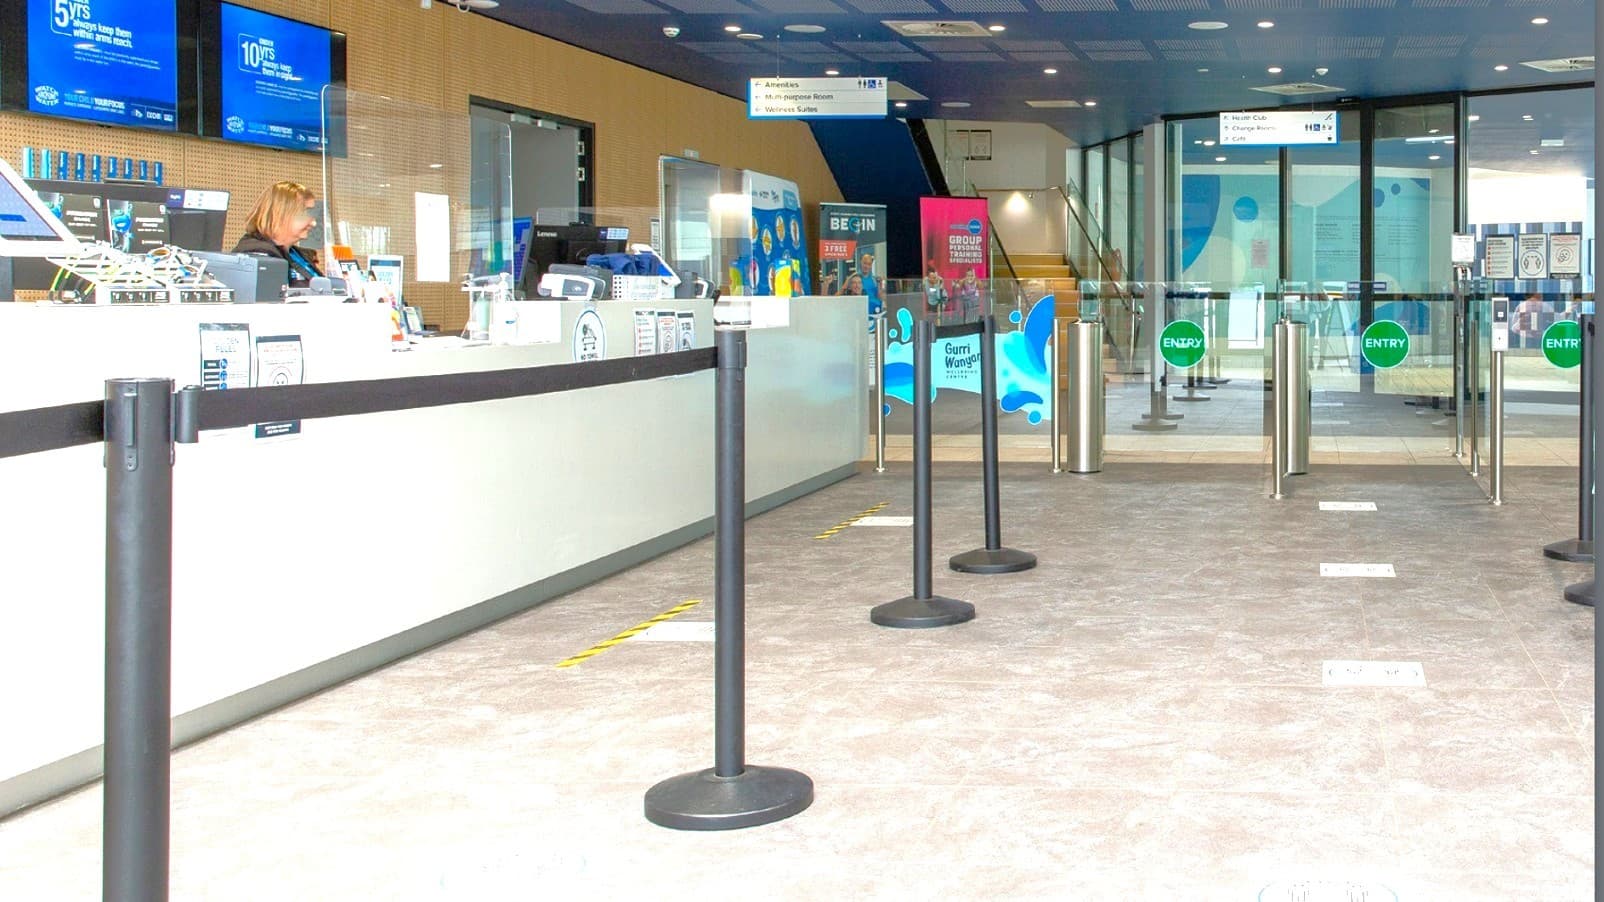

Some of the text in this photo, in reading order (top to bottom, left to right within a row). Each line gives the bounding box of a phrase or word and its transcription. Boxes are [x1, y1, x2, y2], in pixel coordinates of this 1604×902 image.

[54, 0, 91, 28] 5 yrs
[72, 19, 132, 39] always keep them
[73, 28, 94, 41] within
[95, 33, 113, 45] arms
[241, 40, 276, 68] 10 yrs
[262, 59, 280, 71] always
[764, 81, 800, 89] Amenities
[764, 93, 834, 102] Multi-purpose Room
[764, 105, 818, 113] Wellness Suites
[830, 217, 876, 234] BEGIN
[537, 230, 557, 238] Lenovo
[949, 235, 983, 245] GROUP
[945, 342, 971, 355] Gurri
[1163, 337, 1203, 349] ENTRY
[1365, 338, 1406, 349] ENTRY
[1546, 338, 1581, 348] ENTR
